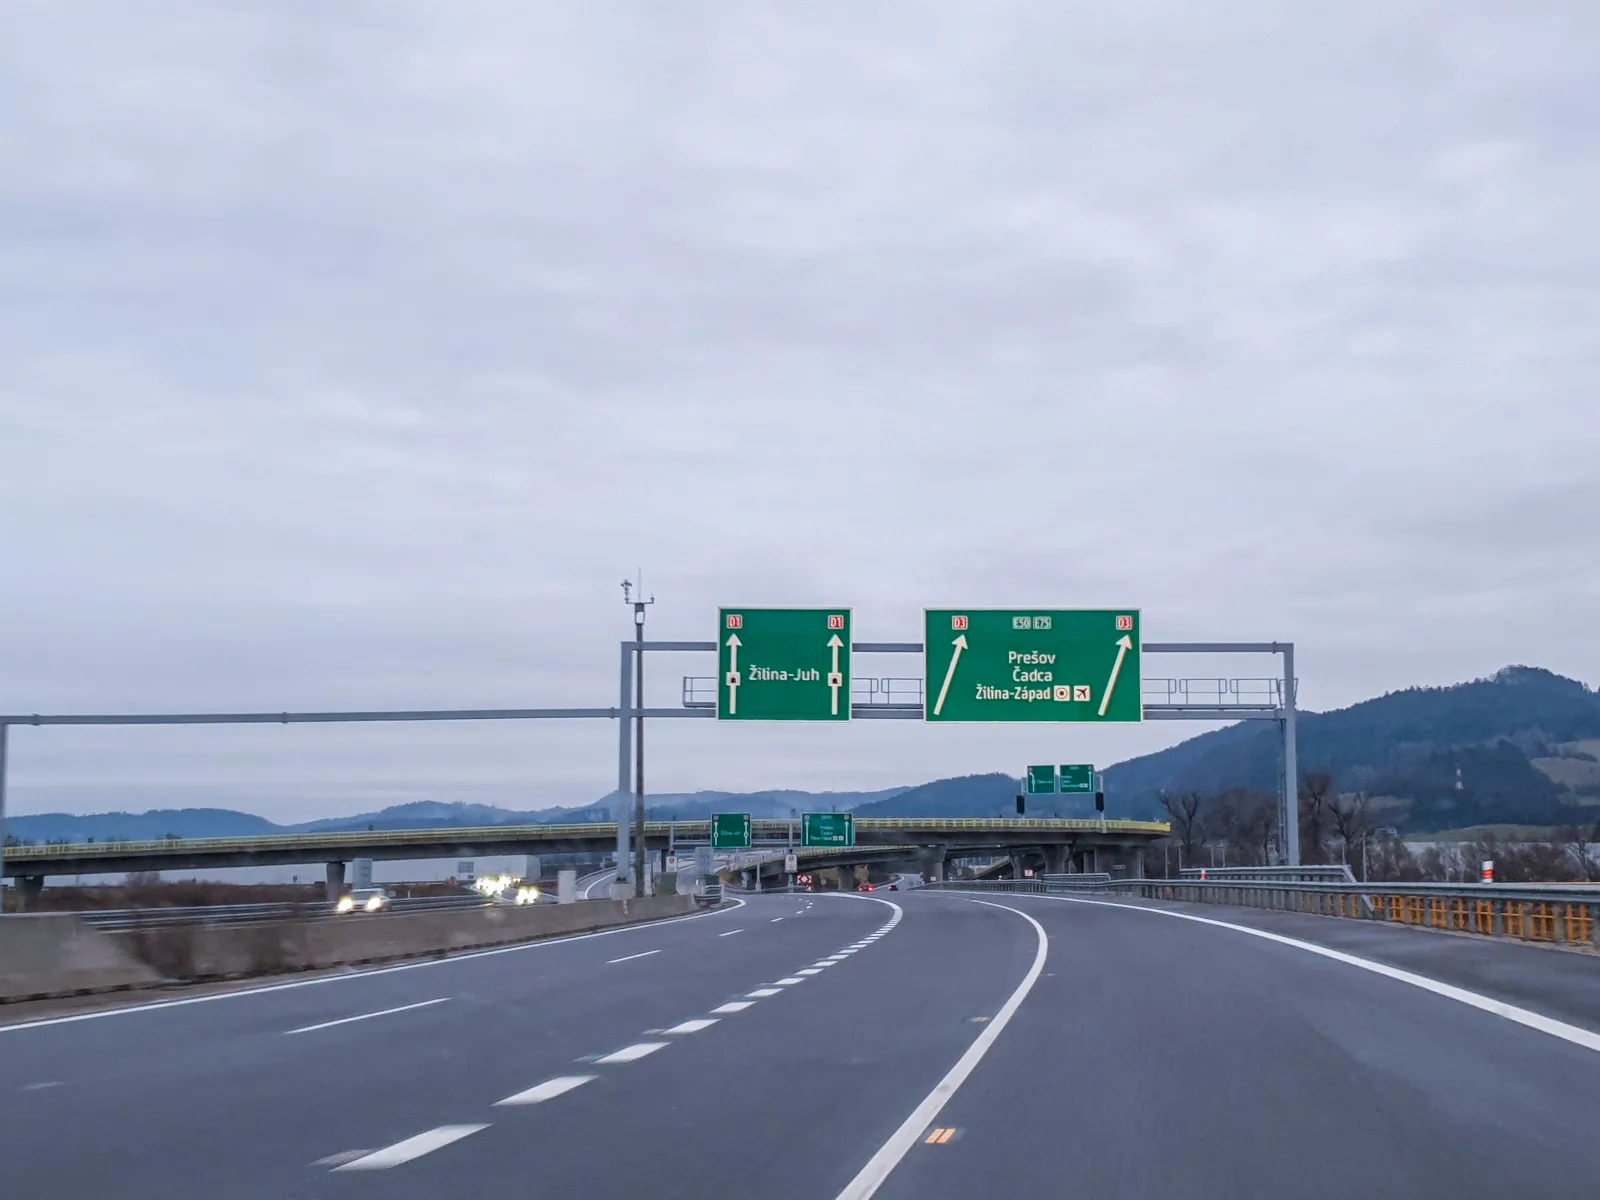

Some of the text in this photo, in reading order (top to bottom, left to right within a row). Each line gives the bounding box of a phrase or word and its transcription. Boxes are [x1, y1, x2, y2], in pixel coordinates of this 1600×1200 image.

[728, 616, 740, 628] D1
[830, 616, 842, 628] D1
[954, 617, 966, 629] D3
[1118, 617, 1131, 629] D3
[1008, 650, 1056, 664] Prešov
[748, 664, 820, 682] Žilina-Juh
[1012, 666, 1053, 682] Čadca
[975, 684, 1051, 702] Žilina-Západ
